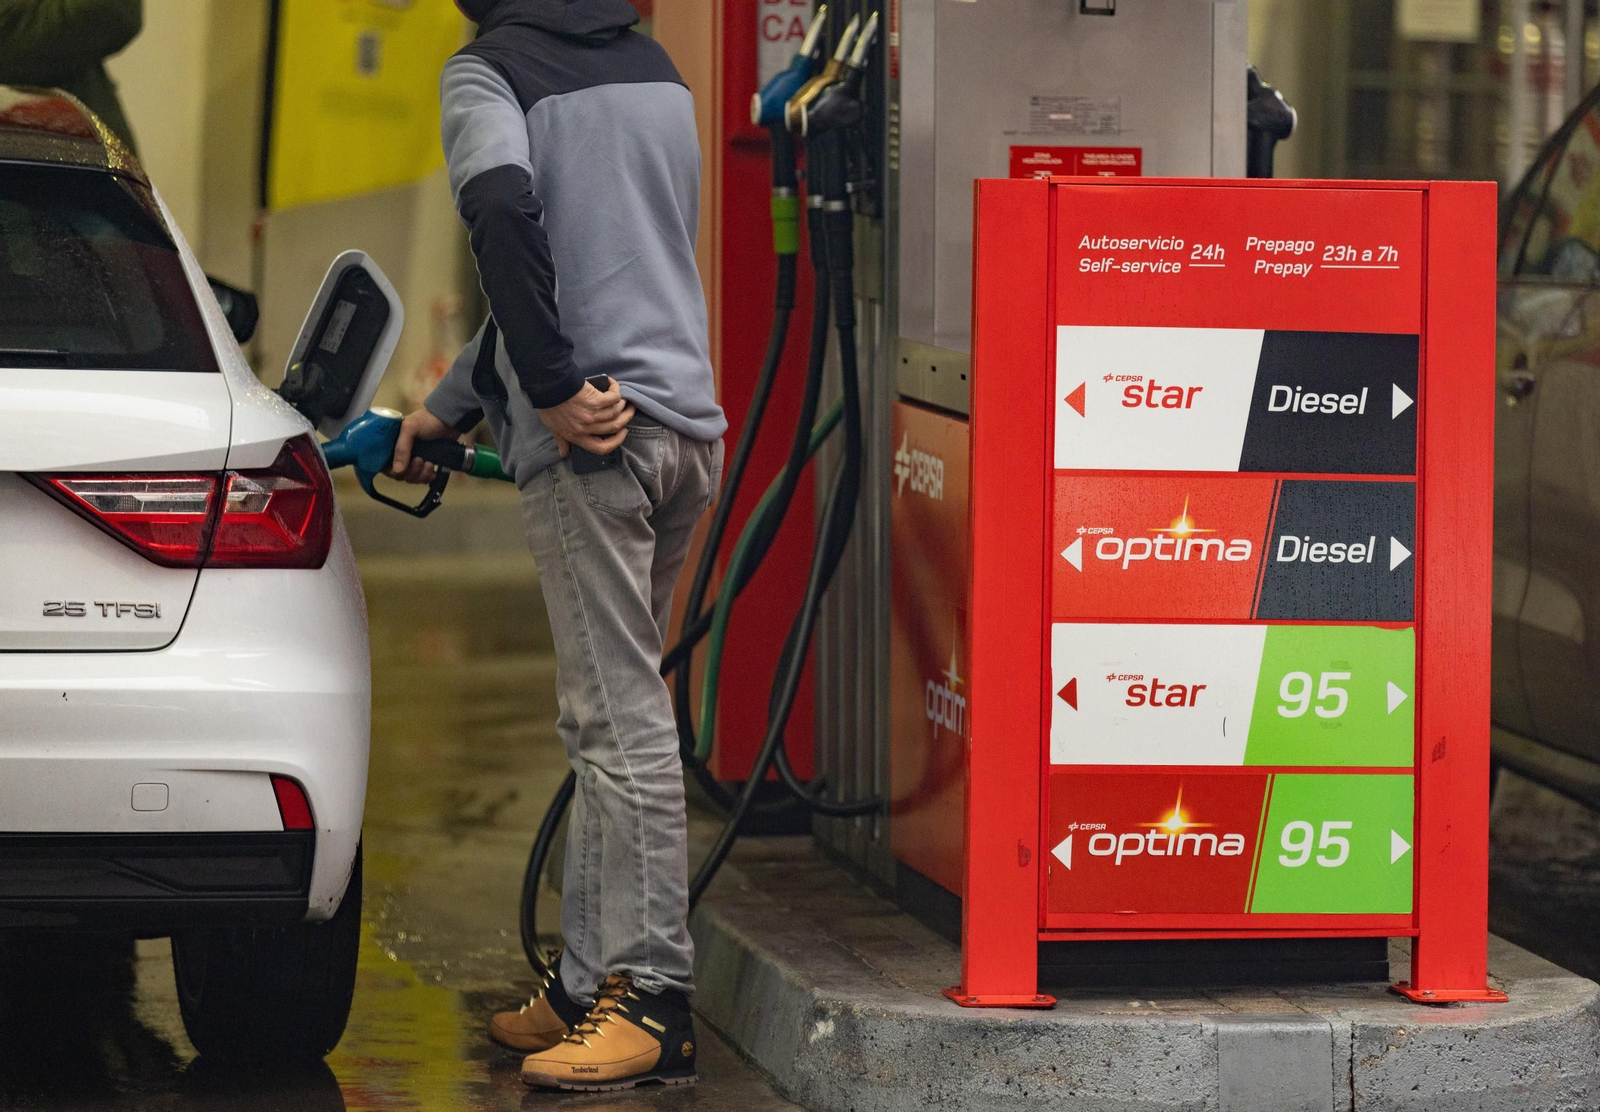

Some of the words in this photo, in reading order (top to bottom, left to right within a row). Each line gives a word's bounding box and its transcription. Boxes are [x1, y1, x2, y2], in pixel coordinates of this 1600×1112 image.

[1078, 235, 1185, 251] Autoservicio
[1190, 244, 1226, 260] 24h
[1245, 236, 1315, 256] Prepago
[1322, 245, 1357, 262] 23h
[1361, 249, 1373, 262] a
[1377, 245, 1399, 262] 7h
[1078, 258, 1182, 274] Self-service
[1254, 259, 1313, 278] Prepay
[1115, 374, 1143, 383] CEPSA
[1121, 379, 1204, 409] star
[1267, 384, 1369, 415] Diesel
[909, 448, 944, 501] CEPSA
[1087, 527, 1114, 535] CEPSA
[1095, 533, 1253, 570] optima
[1276, 535, 1376, 564] Diesel
[42, 601, 86, 617] 25
[93, 601, 161, 619] TFSI
[1125, 678, 1207, 708] star
[1277, 671, 1352, 719] 95
[926, 679, 966, 740] optim
[1079, 823, 1107, 831] CEPSA
[1088, 828, 1245, 866] optima
[1278, 820, 1353, 868] 95
